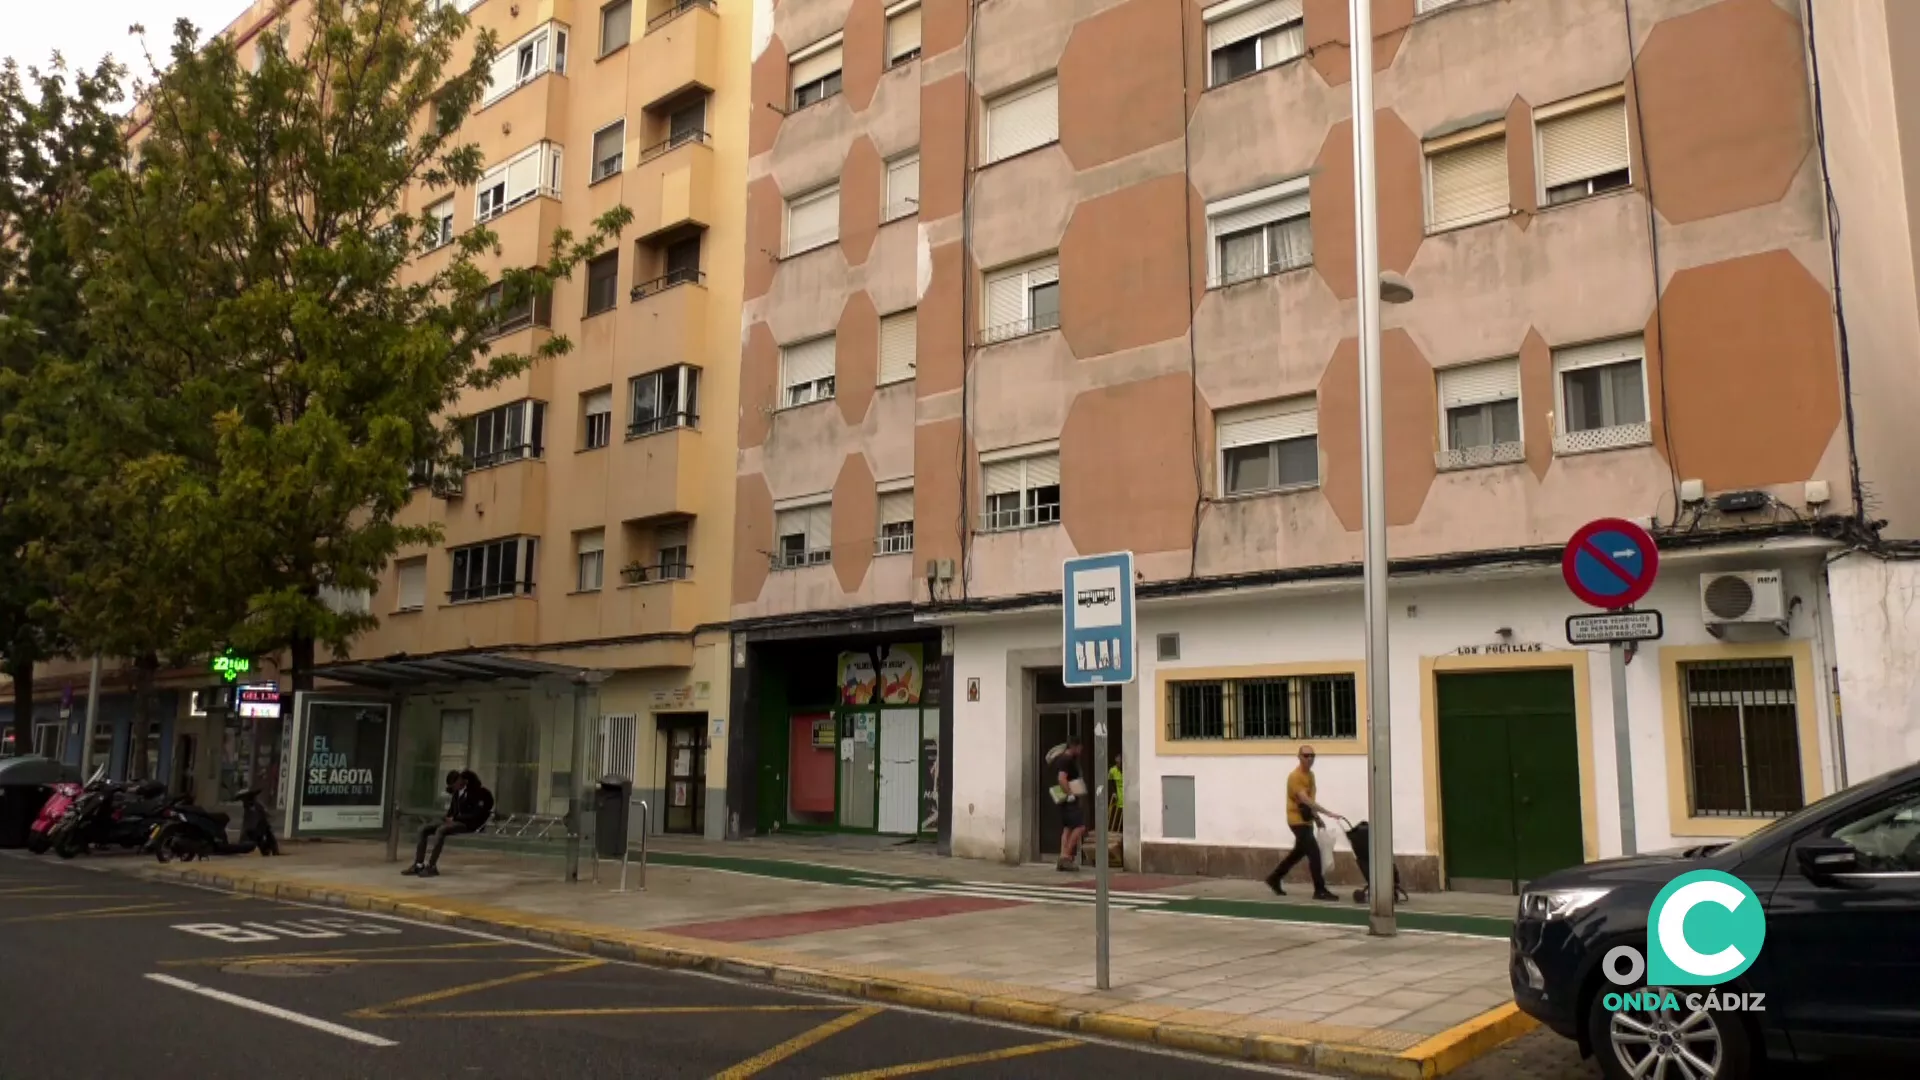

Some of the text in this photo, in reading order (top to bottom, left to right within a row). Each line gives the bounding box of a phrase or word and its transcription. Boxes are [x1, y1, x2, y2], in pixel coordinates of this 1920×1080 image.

[1457, 643, 1542, 655] LOS POLILLAS
[313, 735, 329, 752] EL
[309, 752, 348, 769] AGUA
[309, 768, 373, 785] SE AGOTA
[308, 784, 373, 795] DEPENDE DE TI
